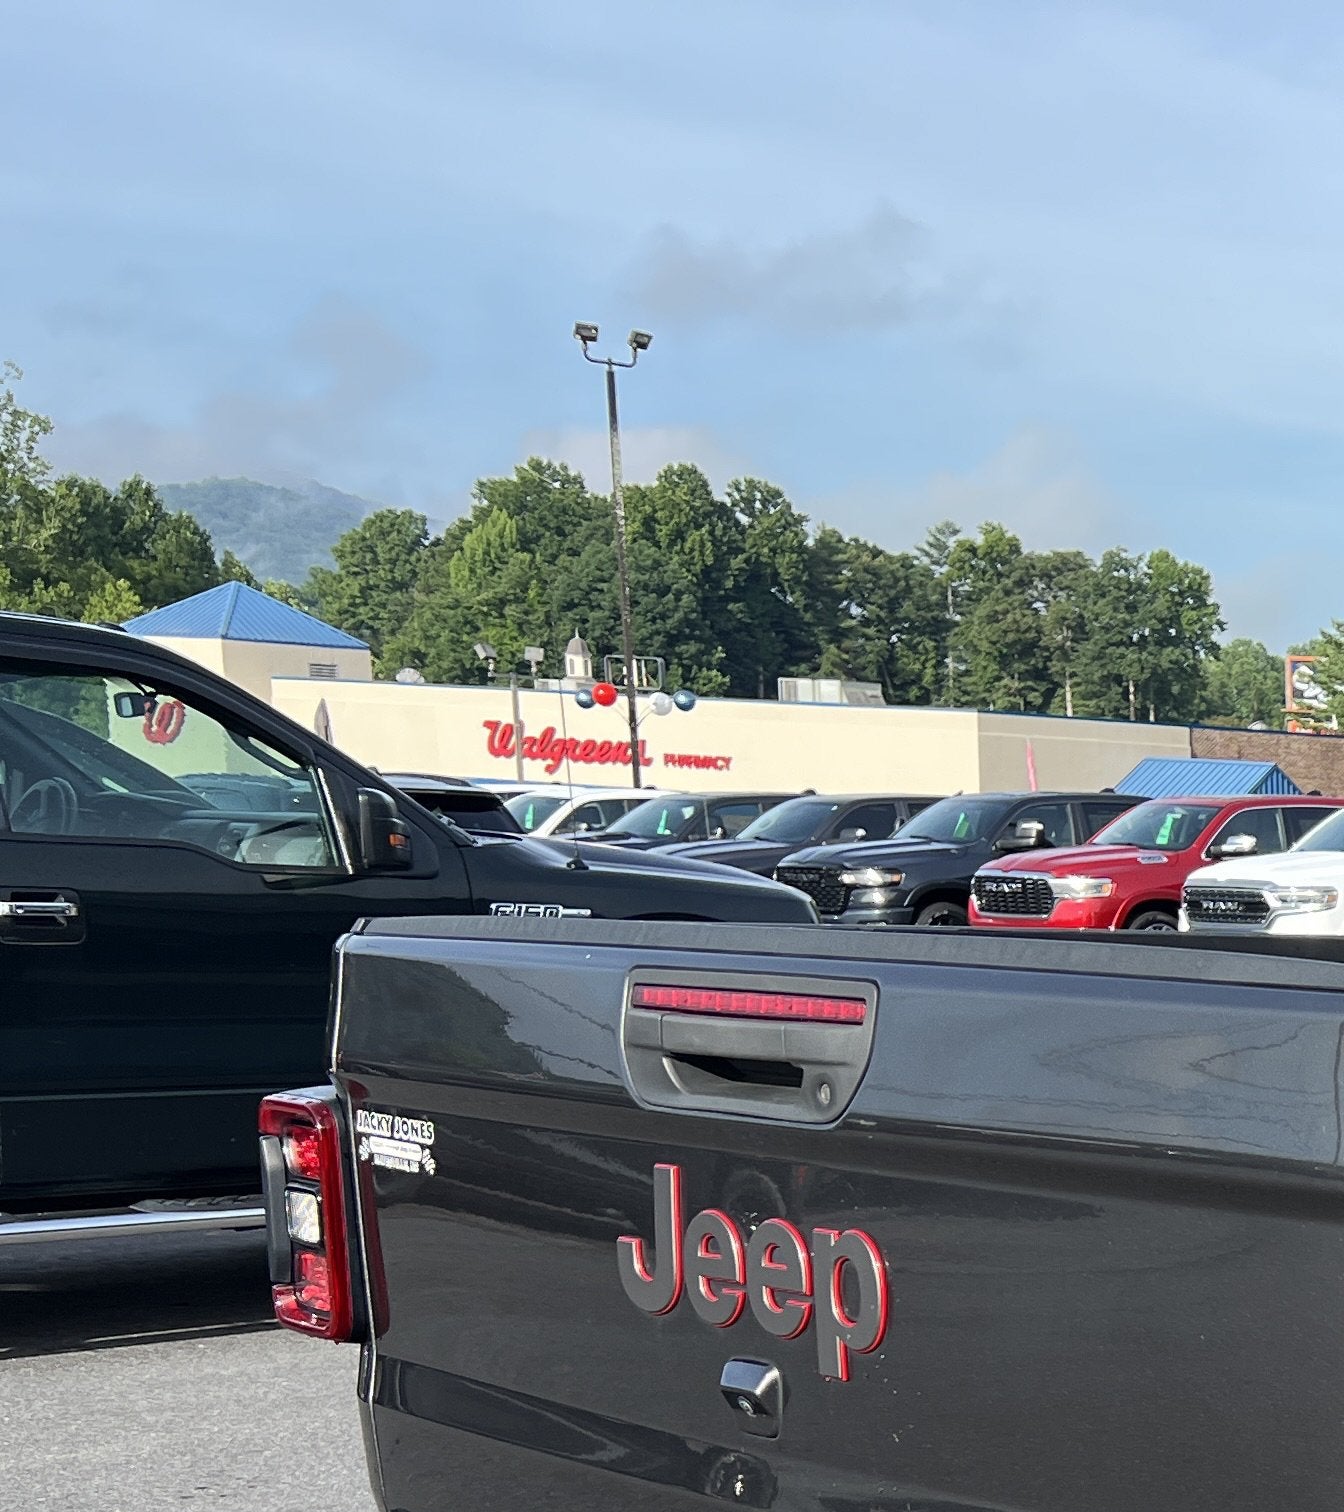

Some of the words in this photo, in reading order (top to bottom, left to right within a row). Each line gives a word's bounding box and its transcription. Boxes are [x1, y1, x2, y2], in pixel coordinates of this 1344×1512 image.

[357, 1110, 393, 1136] JACKY
[393, 1116, 435, 1145] JONES
[616, 1163, 889, 1382] Jeep
